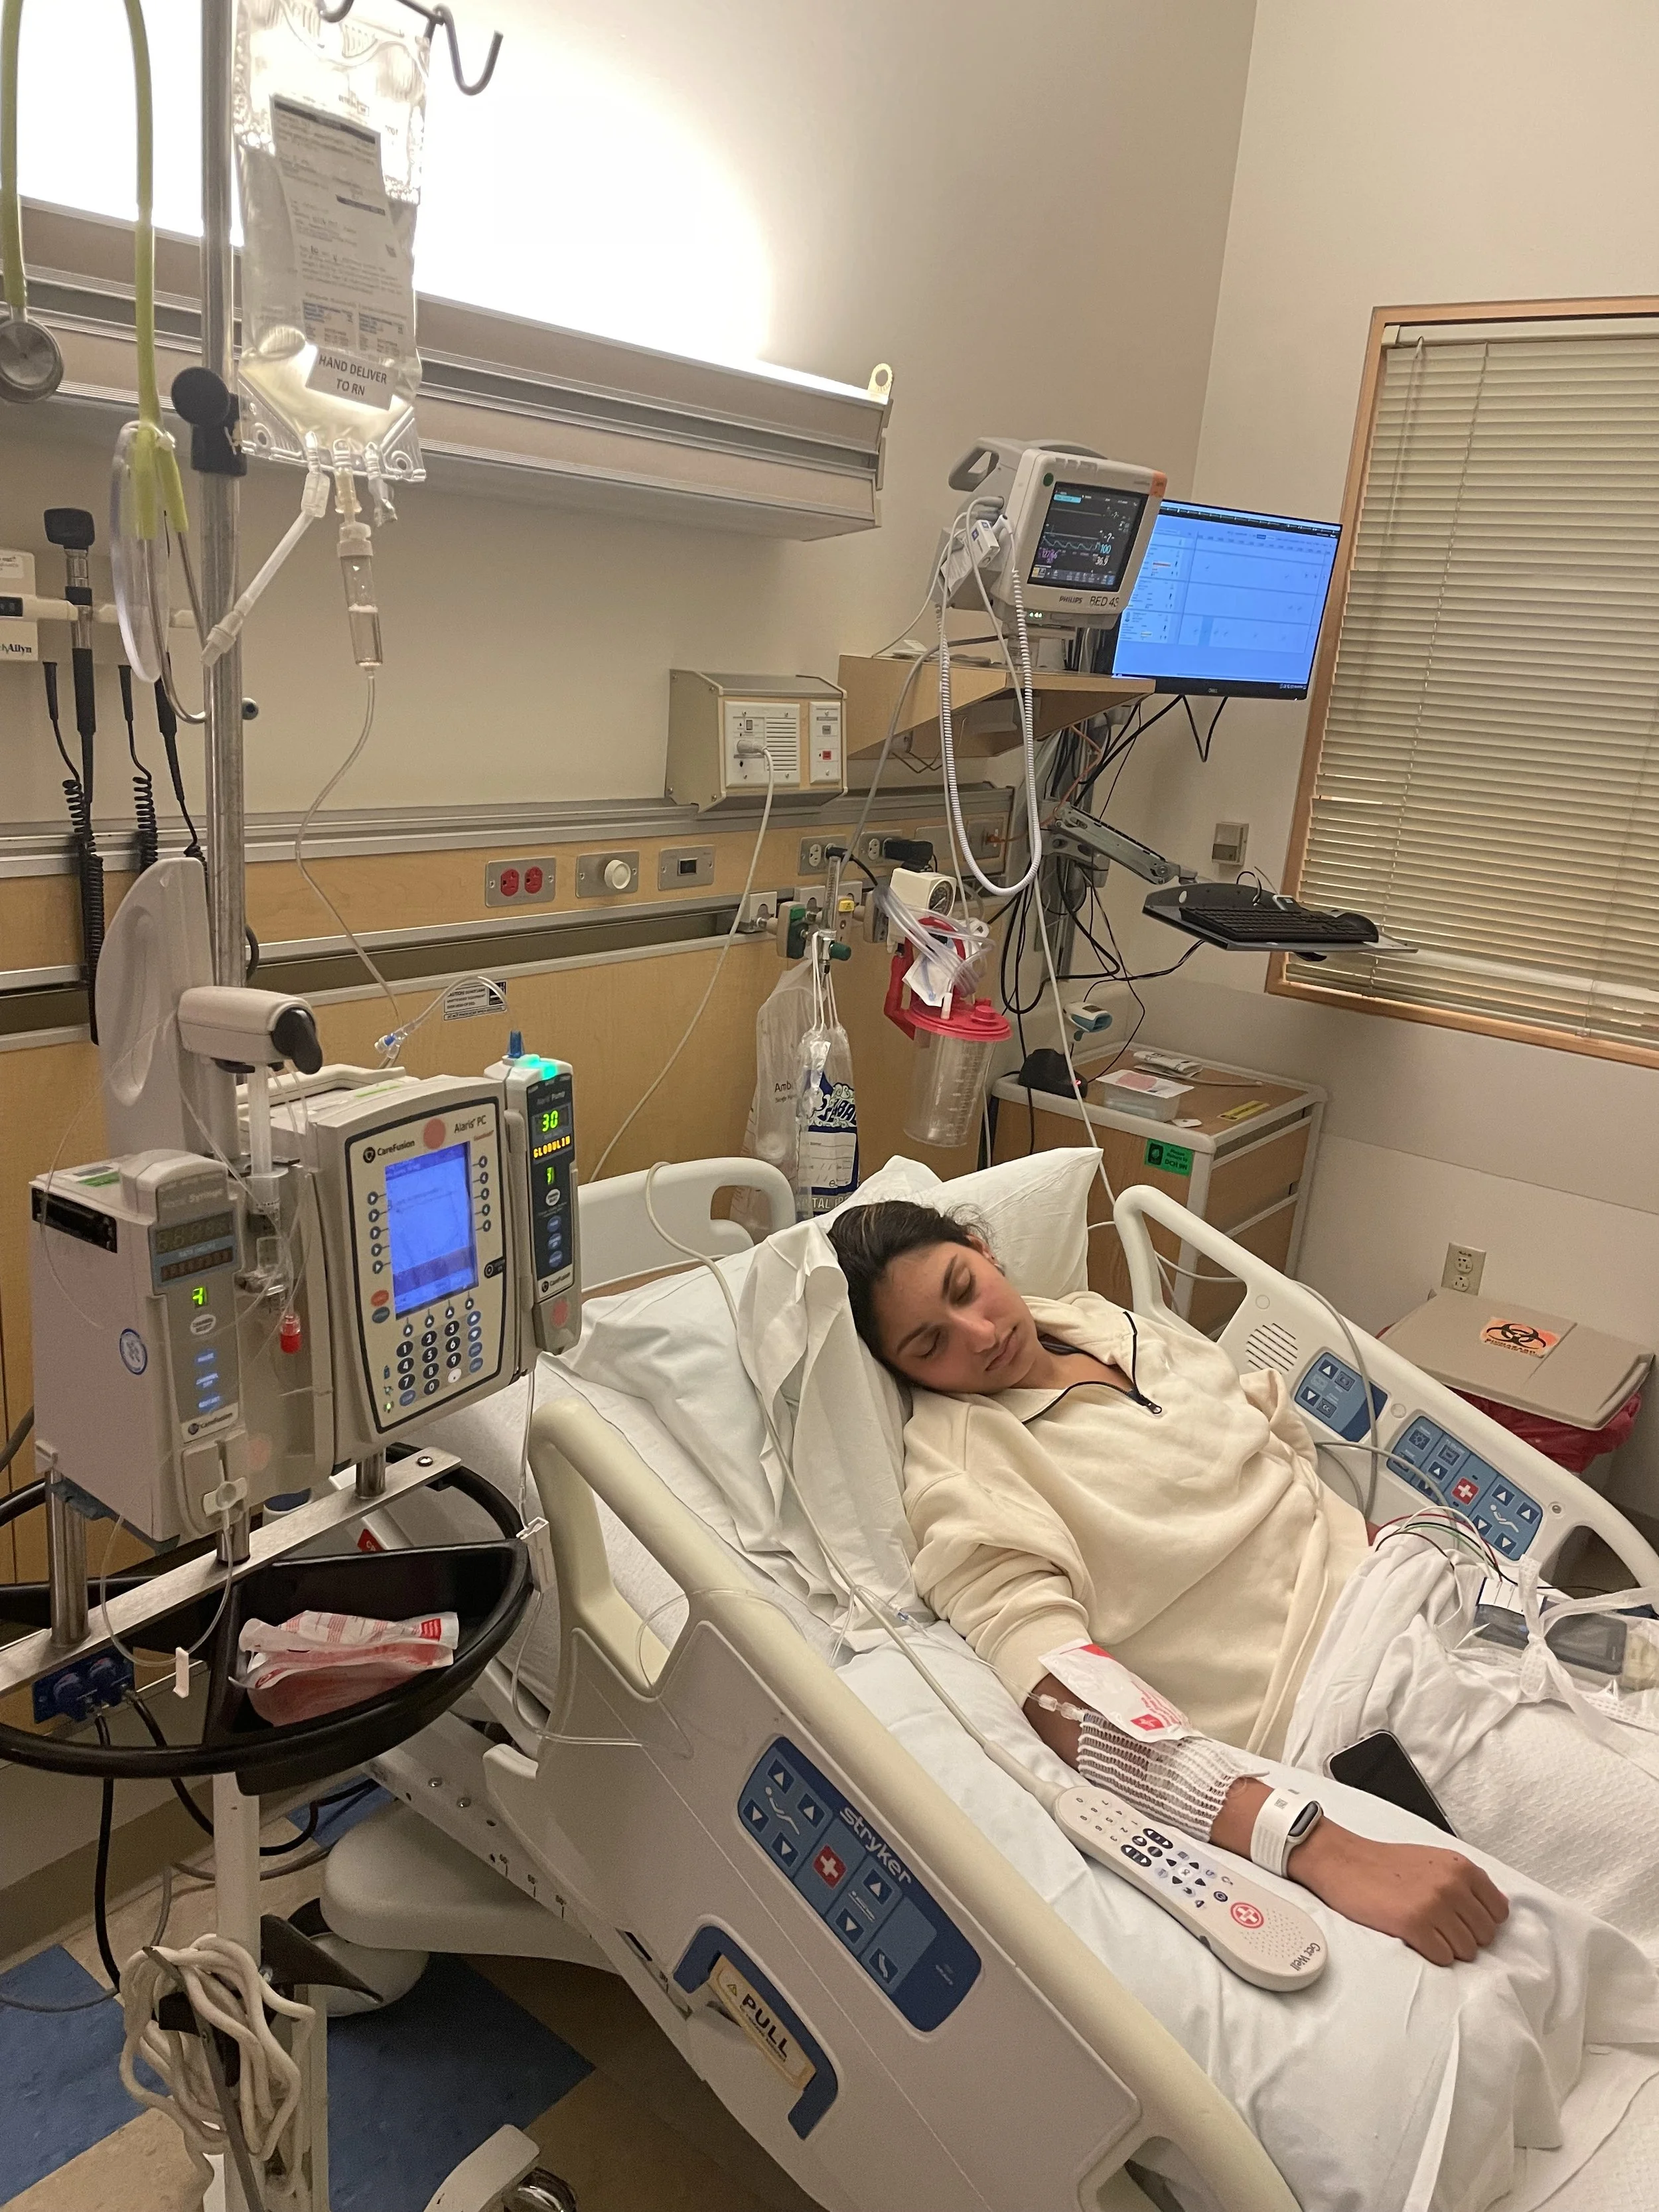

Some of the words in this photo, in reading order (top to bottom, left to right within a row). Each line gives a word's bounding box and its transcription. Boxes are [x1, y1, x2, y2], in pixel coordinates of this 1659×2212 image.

[319, 354, 348, 372] HAND
[350, 364, 387, 384] DELIVER
[336, 378, 350, 391] TO
[351, 383, 365, 396] RN
[1100, 544, 1112, 554] 100
[1089, 596, 1108, 606] BED
[476, 1115, 486, 1126] PC
[542, 1110, 559, 1132] 30
[377, 1140, 415, 1157] CareFusion
[534, 1136, 571, 1158] GLOBULIN
[449, 1324, 455, 1333] 3
[403, 1345, 407, 1353] 1
[450, 1341, 456, 1349] 6
[427, 1351, 432, 1359] 5
[451, 1356, 457, 1364] 9
[403, 1378, 409, 1386] 7
[429, 1382, 435, 1391] 0
[839, 1807, 911, 1884] stryker
[1303, 1943, 1321, 1956] Get
[1289, 1954, 1311, 1971] Well
[742, 1994, 788, 2058] PULL
